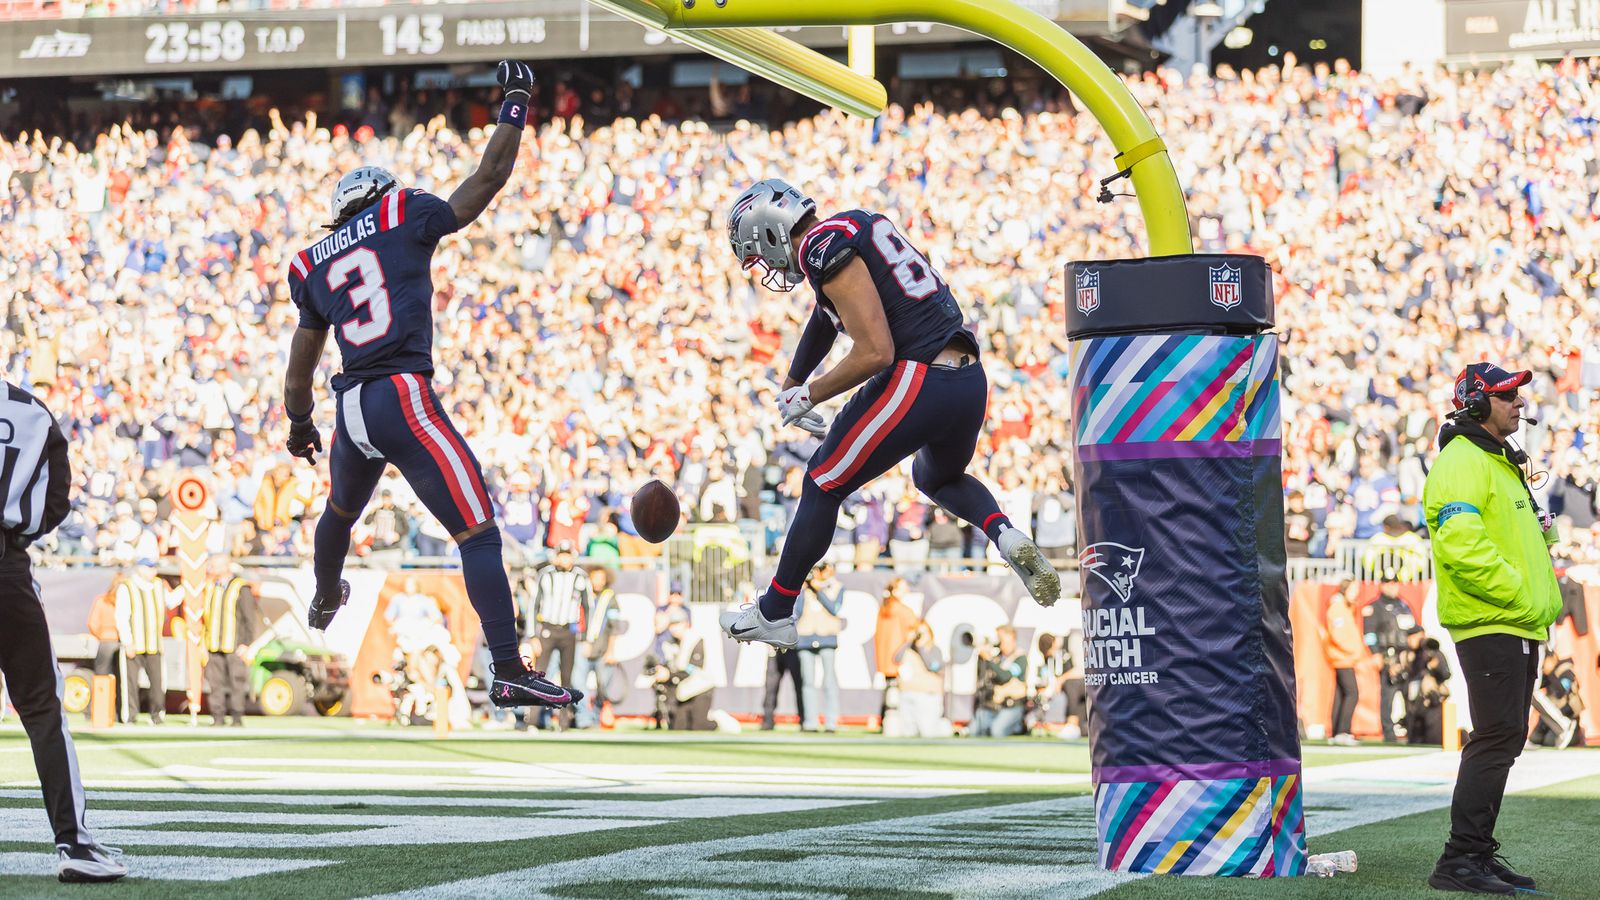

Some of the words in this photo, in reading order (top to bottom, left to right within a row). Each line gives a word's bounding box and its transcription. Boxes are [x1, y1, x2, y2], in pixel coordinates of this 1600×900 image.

[18, 29, 92, 58] JETS
[145, 20, 245, 63] 23:58
[379, 14, 444, 55] 143
[456, 18, 505, 46] PASS
[506, 17, 546, 44] YDS
[312, 213, 377, 265] DOUGLAS
[870, 217, 949, 300] 8
[326, 246, 393, 347] 3
[1078, 289, 1097, 309] NFL
[1213, 283, 1239, 304] NFL
[1081, 606, 1156, 638] RUCIAL
[1084, 673, 1108, 686] ERCEPT
[1109, 671, 1159, 685] CANCER
